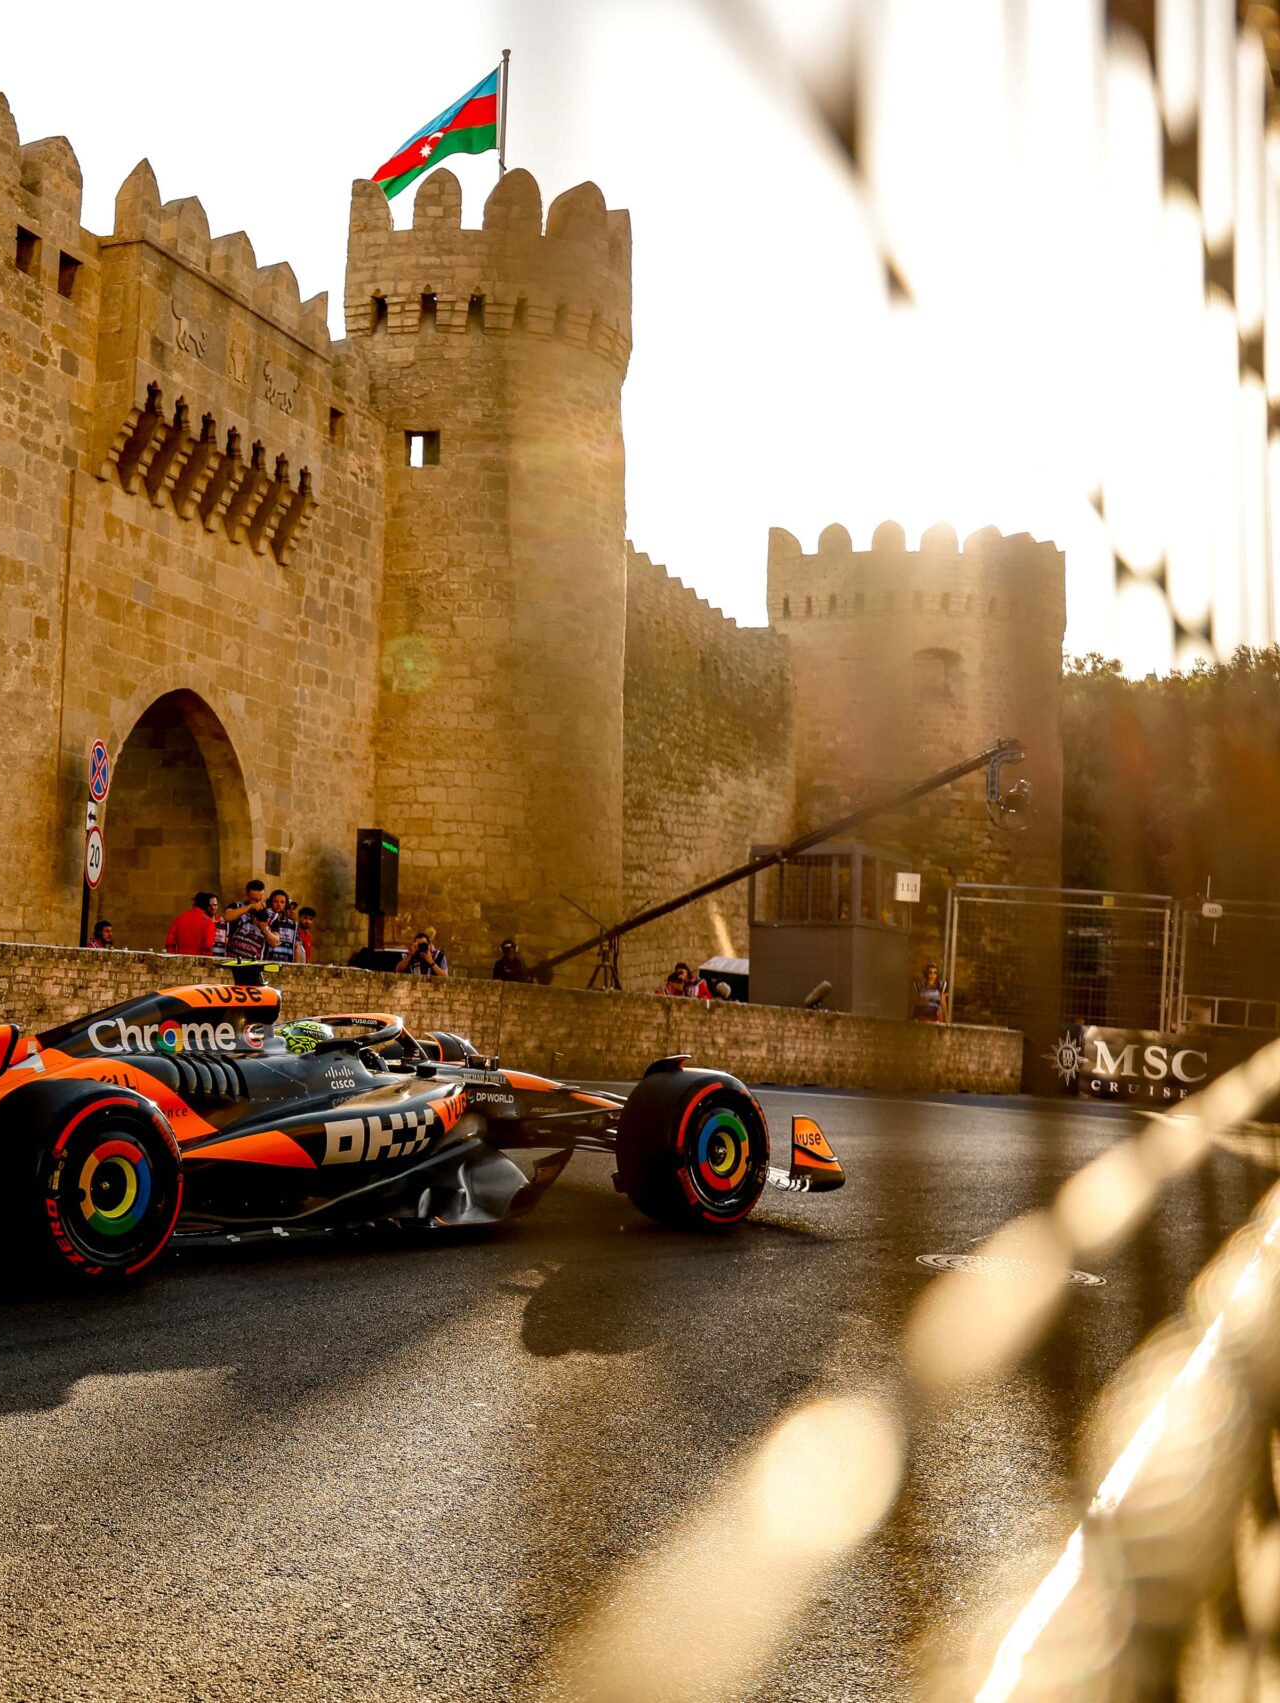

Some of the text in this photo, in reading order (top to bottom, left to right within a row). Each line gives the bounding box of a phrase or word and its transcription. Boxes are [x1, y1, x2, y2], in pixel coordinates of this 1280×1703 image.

[89, 844, 100, 868] 20
[87, 1017, 237, 1054] Chrome
[1092, 1040, 1208, 1083] MSC
[330, 1079, 355, 1090] CISCO
[1091, 1079, 1188, 1099] CRUISE
[476, 1092, 514, 1104] DP WORLD
